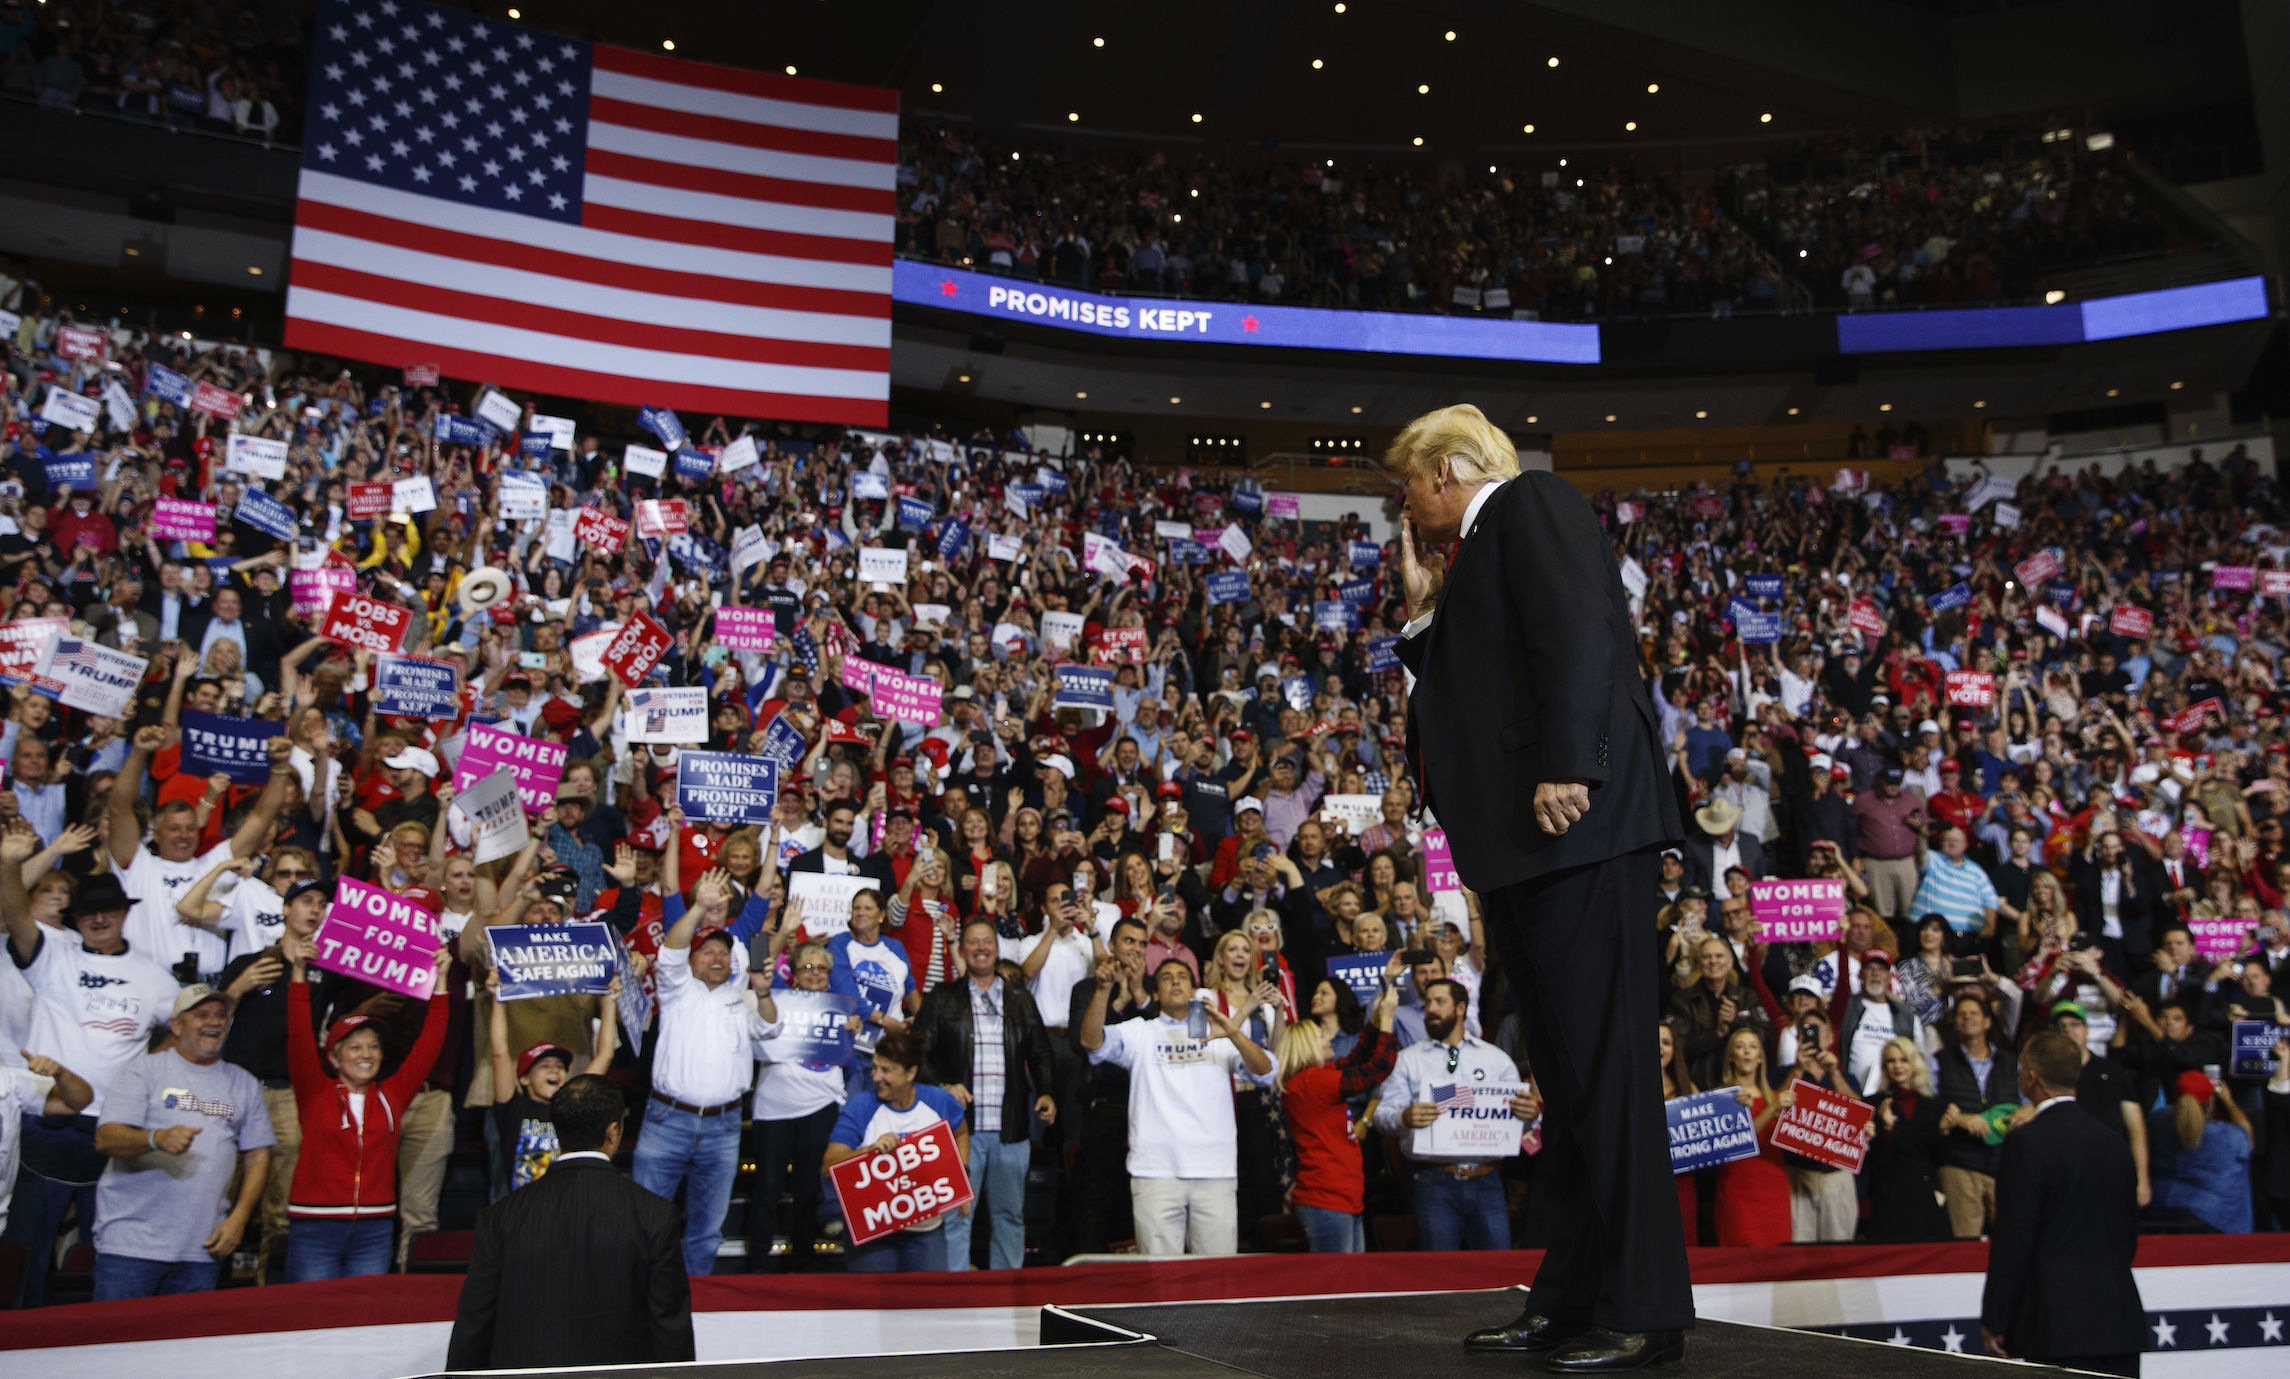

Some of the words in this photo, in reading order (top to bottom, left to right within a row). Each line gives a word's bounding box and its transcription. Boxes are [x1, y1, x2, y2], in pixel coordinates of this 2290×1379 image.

[989, 285, 1131, 329] PROMISES
[1139, 307, 1212, 333] KEPT
[45, 461, 92, 473] TRUMP
[678, 454, 713, 467] TRUMP
[156, 501, 216, 517] WOMEN
[902, 503, 933, 517] TRUMP
[170, 514, 195, 526] FOR
[583, 506, 603, 522] GET
[604, 517, 630, 534] OUT
[153, 524, 213, 540] TRUMP
[578, 521, 620, 551] VOTE
[292, 573, 353, 587] TRUMP
[1747, 580, 1781, 588] TRUMP
[1342, 582, 1372, 596] TRUMP
[341, 597, 401, 627] JOBS
[717, 608, 775, 624] WOMEN
[355, 617, 374, 630] VS.
[735, 620, 757, 634] FOR
[1044, 620, 1078, 630] TRUMP
[0, 622, 57, 643] INISH
[330, 620, 392, 651] MOBS
[608, 617, 647, 664] MOBS
[1103, 632, 1116, 642] ET
[1119, 630, 1143, 641] OUT
[718, 634, 774, 649] TRUMP
[0, 647, 43, 668] WA
[97, 651, 143, 671] VETERANS
[626, 635, 663, 681] JOBS
[69, 660, 136, 689] TRUMP
[386, 663, 451, 681] PROMISES
[1947, 673, 1969, 683] GET
[1970, 673, 1992, 685] OUT
[38, 676, 65, 693] 2020
[401, 675, 438, 689] MADE
[876, 672, 943, 697] WOMEN
[1060, 675, 1110, 687] TRUMP
[384, 686, 451, 704] PROMISES
[893, 692, 918, 706] FOR
[1949, 689, 1991, 704] VOTE
[399, 700, 433, 713] KEPT
[649, 707, 705, 717] TRUMP
[875, 699, 937, 722] TRUMP
[193, 742, 267, 762] PENCE
[470, 726, 568, 767] WOMEN
[689, 759, 769, 778] PROMISES
[706, 773, 753, 788] MADE
[1195, 781, 1225, 793] TRUMP
[460, 771, 553, 808] TMP
[475, 790, 516, 822] TRUMP
[687, 790, 768, 807] PROMISES
[705, 803, 749, 818] KEPT
[820, 884, 850, 895] KEEP
[1752, 884, 1843, 901] WOMEN
[340, 881, 443, 941] WOMEN
[804, 899, 852, 913] MERI
[1781, 904, 1814, 917] FOR
[813, 916, 845, 928] GREA
[1761, 920, 1839, 938] TRUMP
[364, 924, 408, 951] FOR
[529, 932, 572, 943] MAKE
[646, 920, 667, 948] GE
[2209, 938, 2237, 949] FOR
[321, 937, 429, 988] TRUMP
[500, 944, 613, 966] AMERICA
[511, 966, 554, 983] SAFE
[556, 964, 606, 979] AGAIN
[1335, 966, 1412, 980] TRU
[1347, 975, 1406, 987] ENE
[107, 996, 140, 1016] #45
[783, 1010, 849, 1028] RUMP
[783, 1027, 839, 1039] ENCE
[1157, 1042, 1208, 1053] TRUMP
[1471, 1086, 1525, 1096] VETERAN
[1680, 1102, 1715, 1120] MAKE
[1816, 1099, 1849, 1119] MAKE
[1668, 1111, 1749, 1143] MERICA
[1783, 1104, 1866, 1146] AMERICA
[1450, 1130, 1511, 1141] AMERICA
[1779, 1121, 1822, 1147] PROUD
[1824, 1137, 1861, 1160] AGAIN
[1670, 1141, 1712, 1161] TRONG
[1713, 1130, 1752, 1151] AGAIN
[854, 1134, 941, 1189] JOBS
[862, 1176, 956, 1232] MOBS
